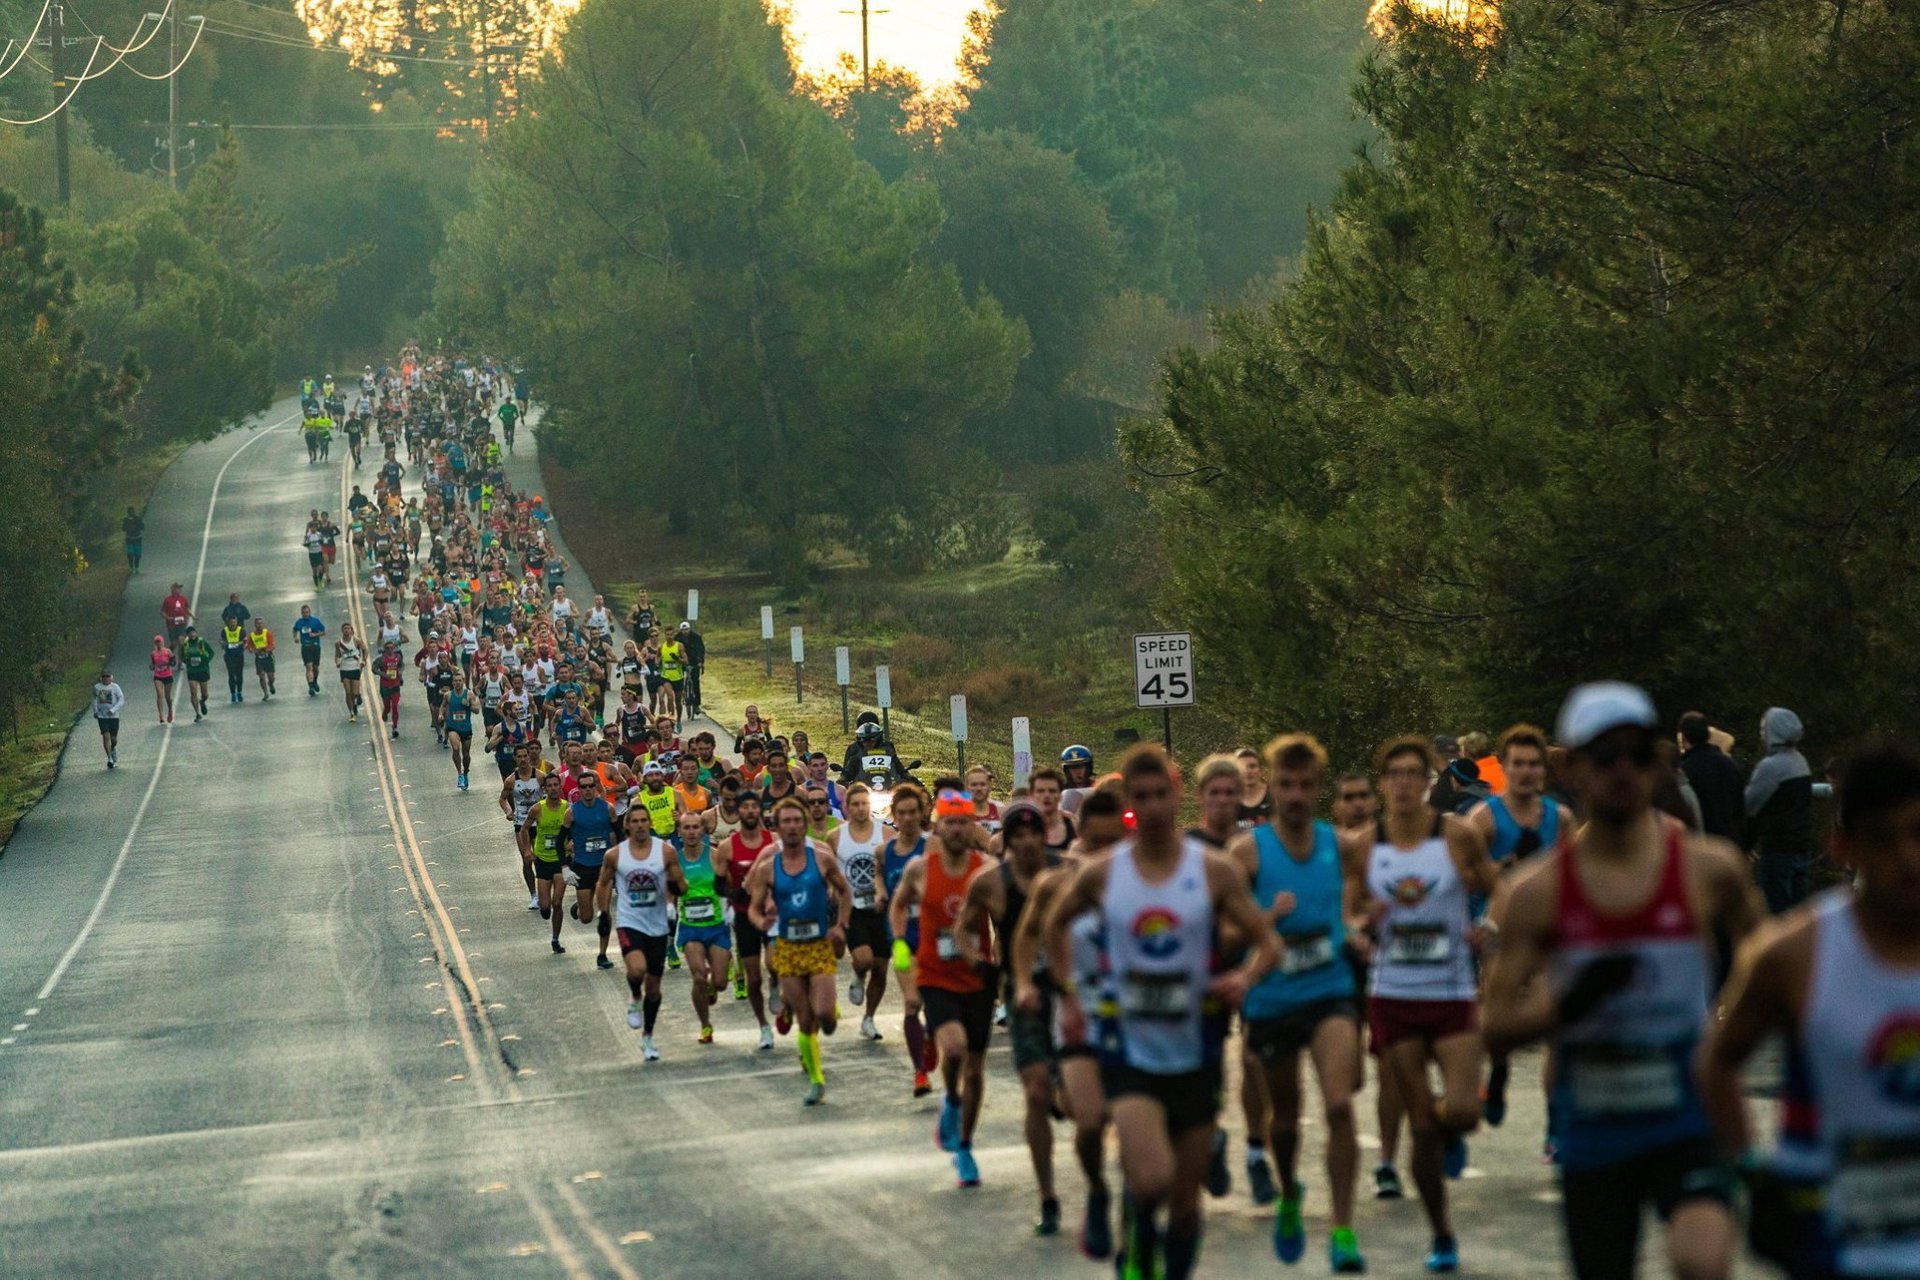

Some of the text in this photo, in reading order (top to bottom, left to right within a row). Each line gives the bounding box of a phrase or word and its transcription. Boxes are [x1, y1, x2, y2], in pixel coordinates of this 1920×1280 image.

[1139, 640, 1187, 653] SPEED
[1145, 656, 1184, 669] LIMIT
[1141, 672, 1190, 700] 45
[869, 757, 885, 766] 42
[648, 797, 671, 811] GUIDE
